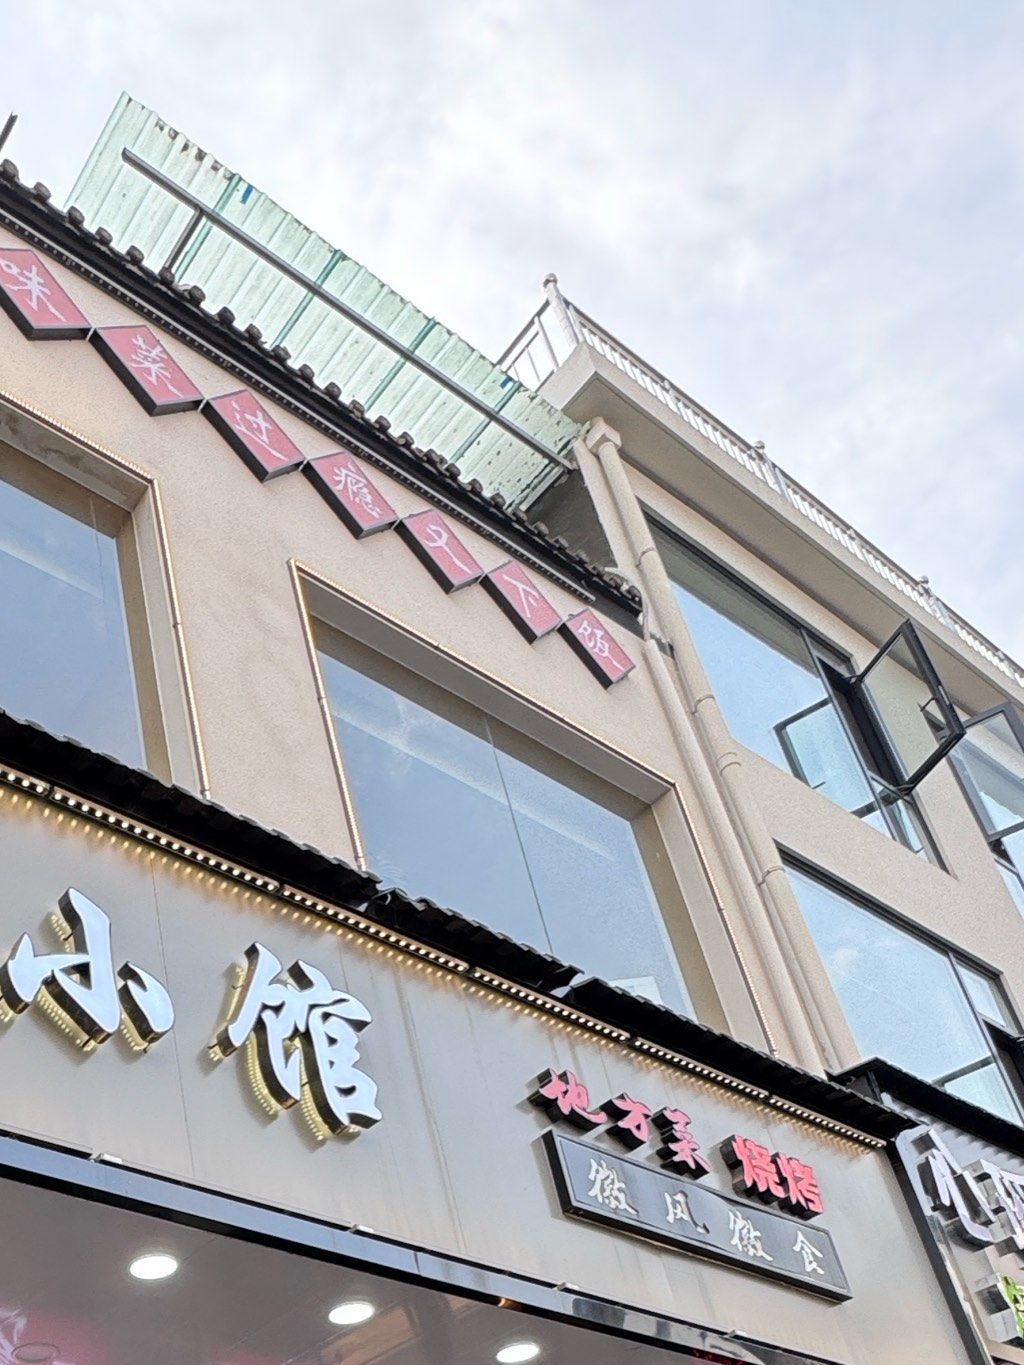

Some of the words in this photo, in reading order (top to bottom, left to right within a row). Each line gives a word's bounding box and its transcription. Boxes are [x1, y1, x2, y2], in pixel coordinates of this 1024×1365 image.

[532, 1067, 712, 1177] 地方菜
[725, 1134, 825, 1218] 烧烤
